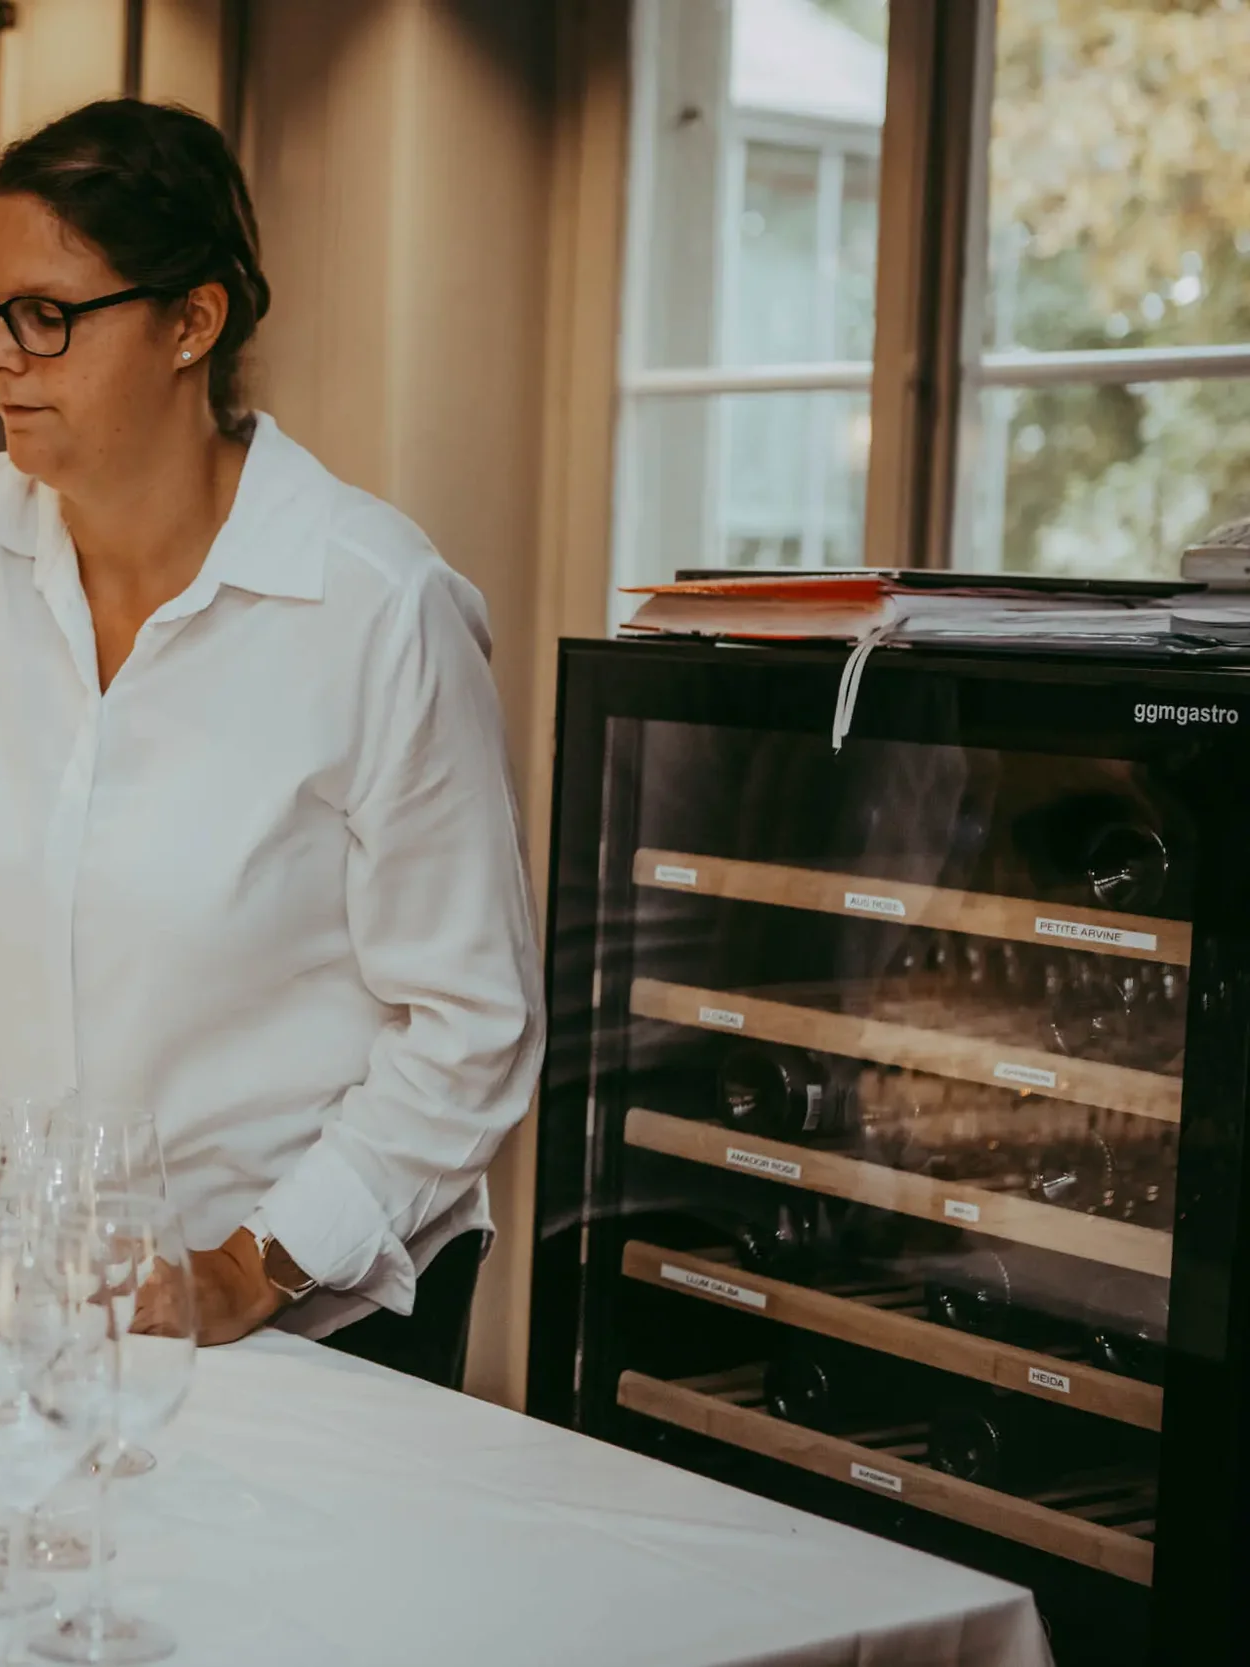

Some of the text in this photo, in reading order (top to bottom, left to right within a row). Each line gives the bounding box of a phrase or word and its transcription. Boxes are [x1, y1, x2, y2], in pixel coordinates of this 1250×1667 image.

[1134, 703, 1239, 726] ggmgastro
[1040, 921, 1123, 942] PETITE ARVINE
[1032, 1372, 1065, 1388] HEIDA
